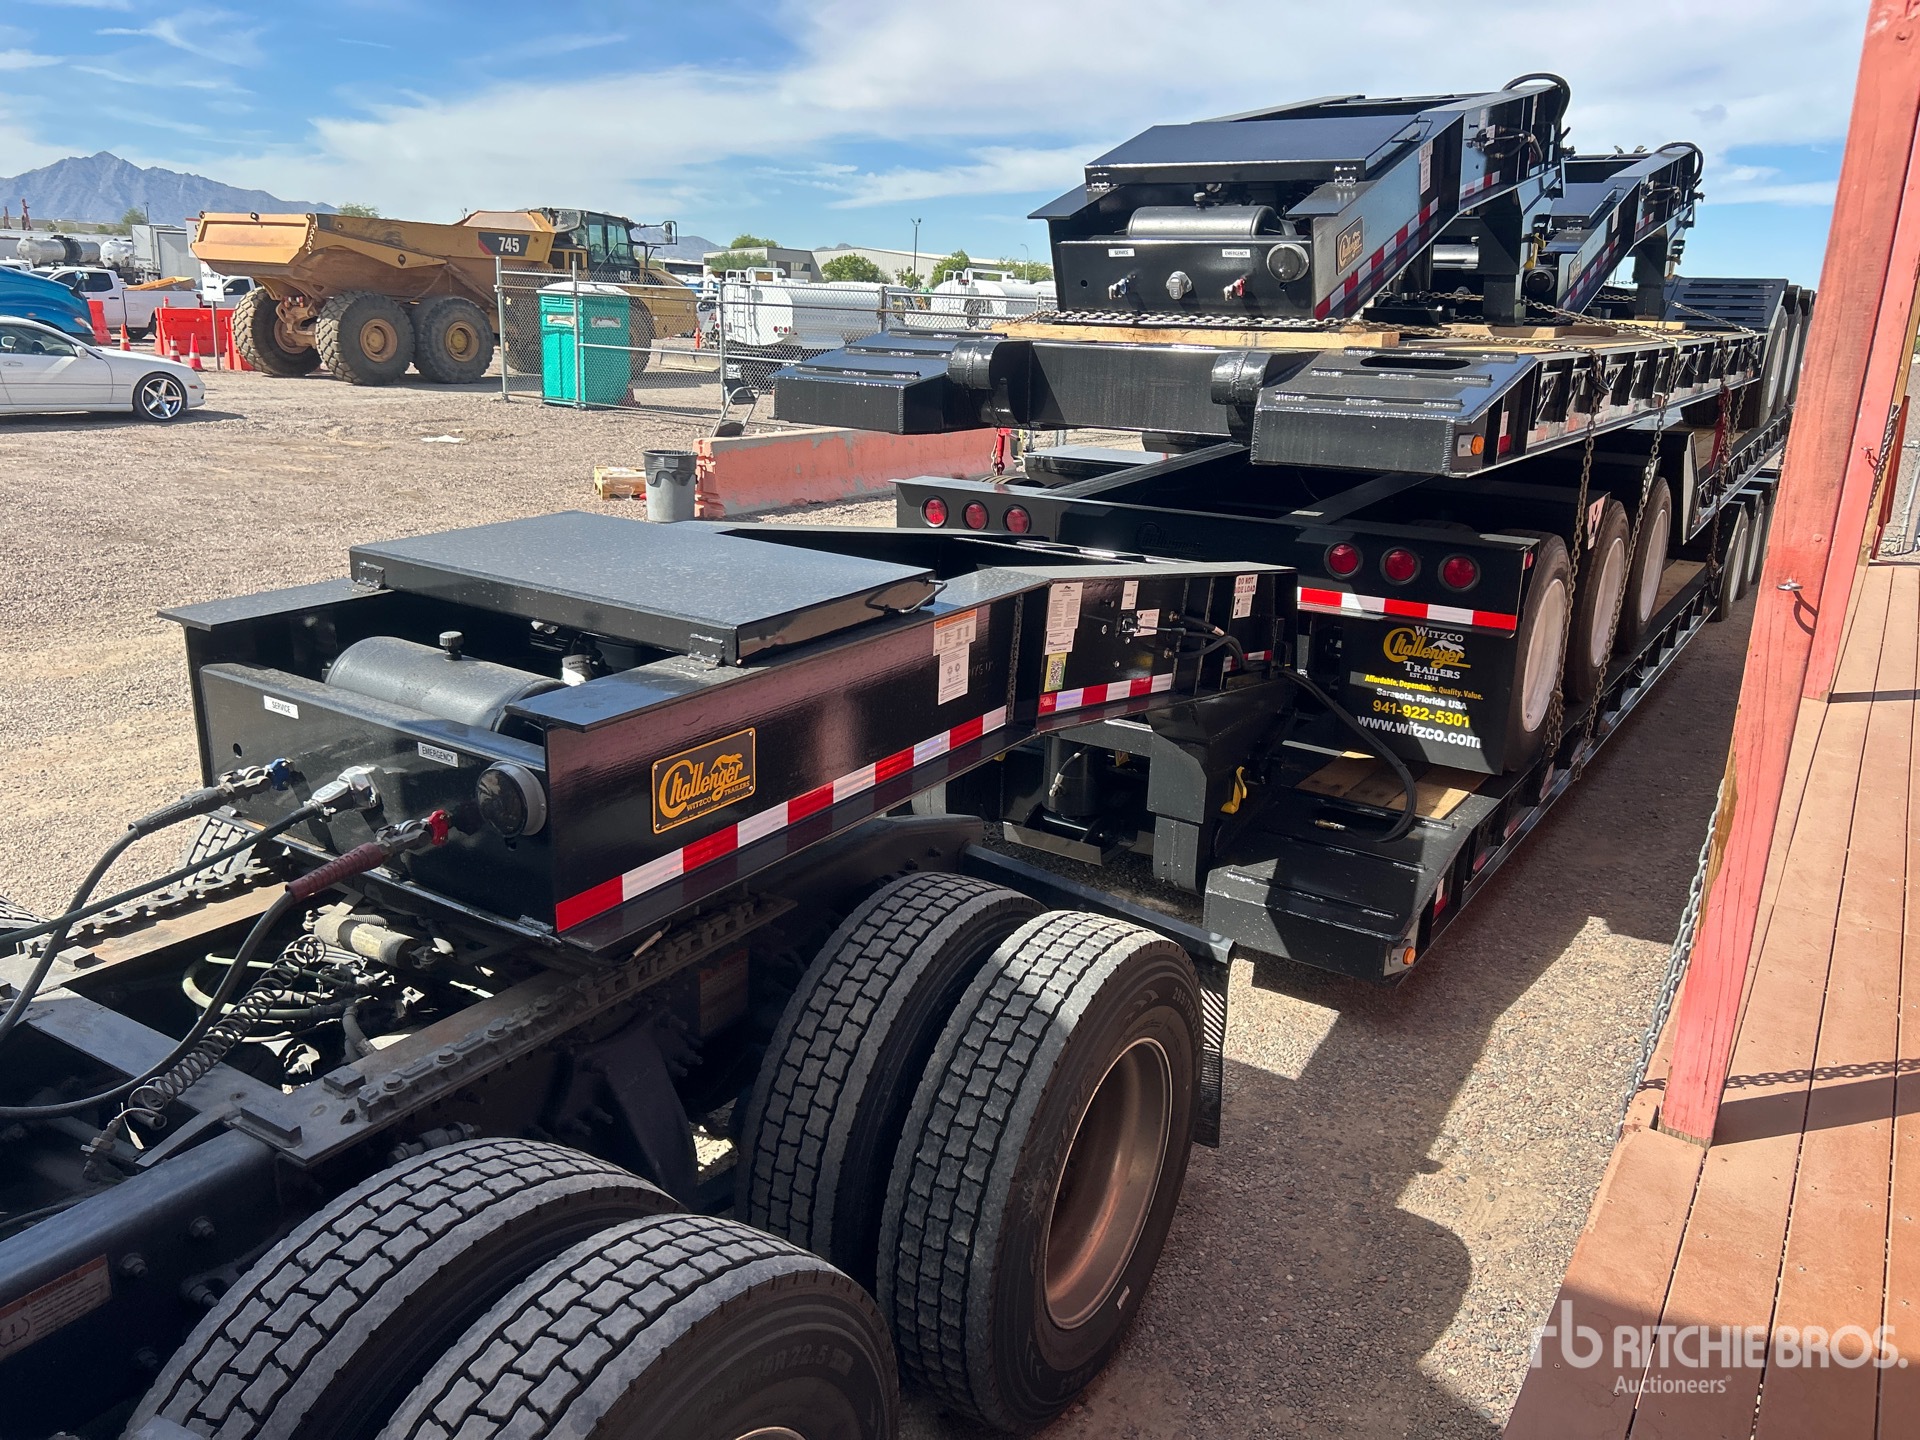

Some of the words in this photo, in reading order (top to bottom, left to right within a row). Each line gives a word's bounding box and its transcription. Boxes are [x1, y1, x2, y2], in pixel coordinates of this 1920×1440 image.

[498, 236, 520, 253] 745
[1415, 625, 1464, 642] WITZCO
[1383, 627, 1472, 669] Challenger
[1403, 661, 1461, 679] TRAILERS
[1409, 672, 1423, 680] EST.
[1365, 674, 1399, 686] Affordable.
[1399, 680, 1437, 692] Dependable.
[1438, 686, 1463, 698] Quality.
[1463, 690, 1484, 700] Value.
[271, 701, 291, 713] SERVICE
[1376, 688, 1414, 702] Sarasota,
[1416, 694, 1446, 707] Florida
[1448, 699, 1468, 710] USA
[1372, 699, 1470, 728] 941-922-5301
[1356, 715, 1482, 749] www.witzco.com
[421, 746, 455, 763] EMERGENCY
[658, 759, 751, 819] Challenger
[686, 796, 712, 811] WITZCO
[724, 780, 751, 796] TRAILERS
